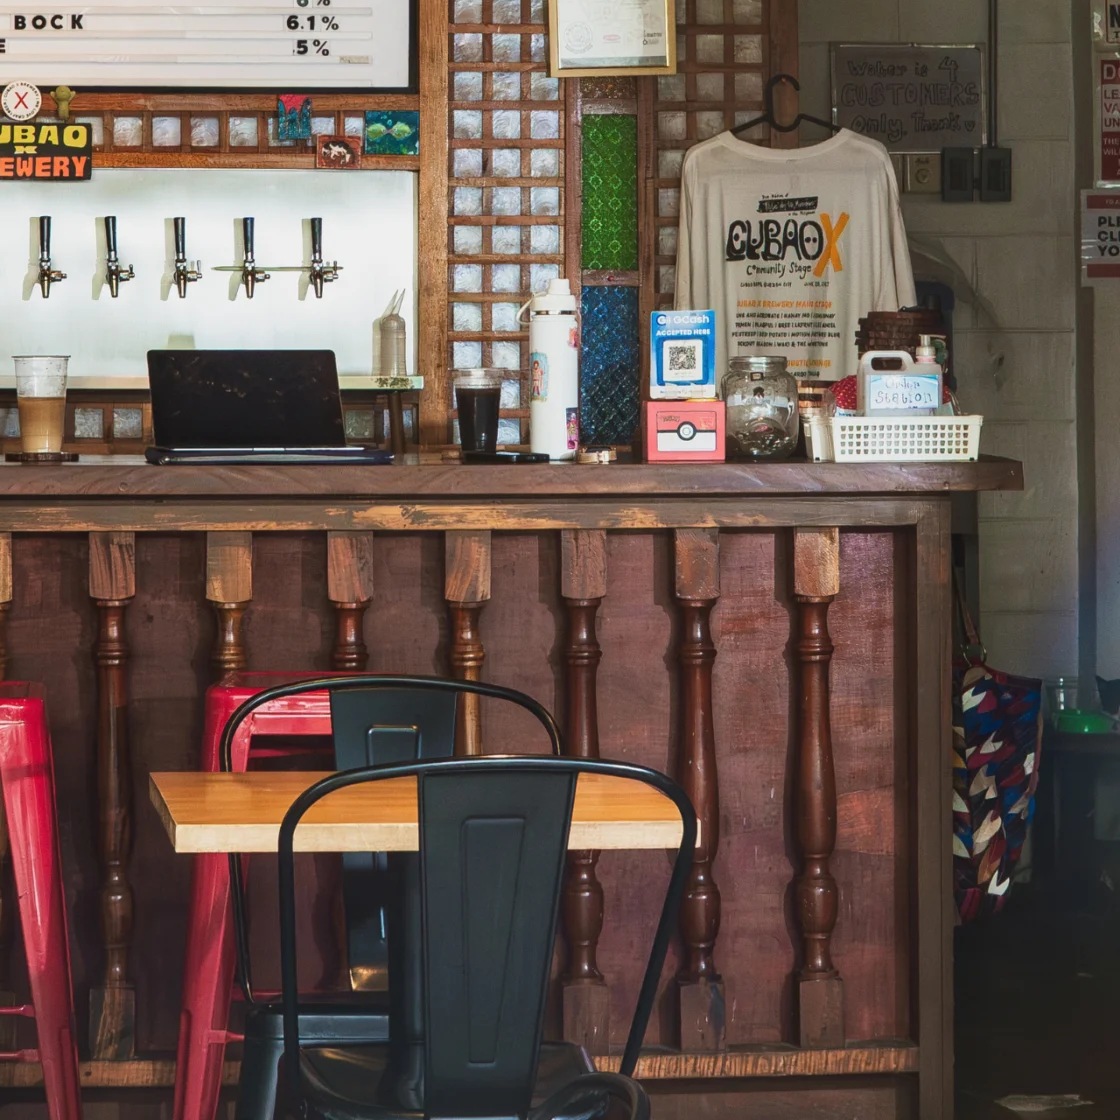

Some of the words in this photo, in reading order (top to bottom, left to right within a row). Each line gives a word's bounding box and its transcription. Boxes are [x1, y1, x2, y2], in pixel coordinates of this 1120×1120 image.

[14, 14, 84, 30] BOCK
[286, 15, 340, 31] 6.1%
[296, 39, 330, 56] 5%
[847, 60, 907, 78] Water
[914, 61, 929, 77] is
[938, 56, 959, 82] 4
[1103, 64, 1120, 80] D
[841, 82, 980, 107] CUSTOMERS
[746, 264, 787, 278] Community
[789, 262, 812, 279] Stage
[674, 314, 710, 325] GCash
[656, 328, 692, 336] ACCEPTED
[875, 390, 933, 405] Station
